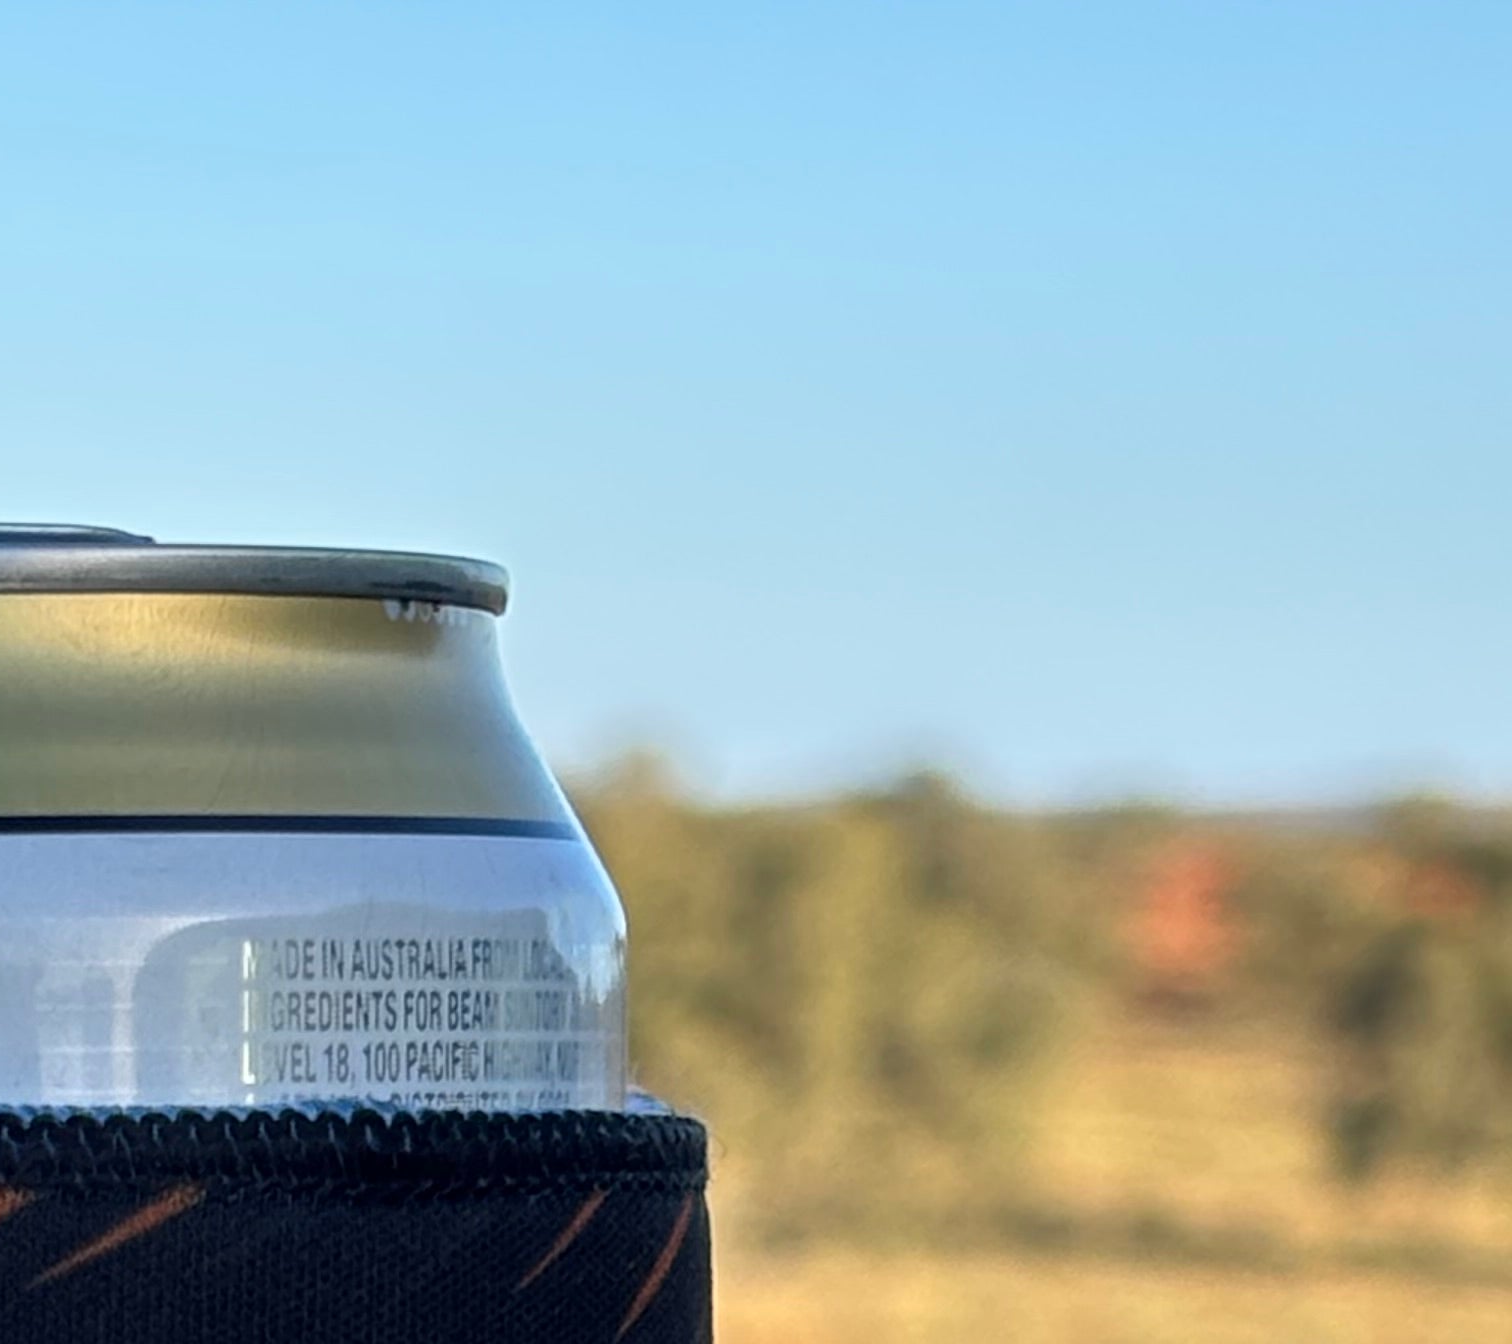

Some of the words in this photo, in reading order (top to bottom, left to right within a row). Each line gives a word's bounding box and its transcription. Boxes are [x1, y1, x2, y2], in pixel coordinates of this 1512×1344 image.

[321, 939, 344, 980] IN
[351, 938, 468, 980] AUSTRALIA
[403, 990, 442, 1032] FOR
[324, 1042, 356, 1089] 18,
[363, 1041, 400, 1082] 100
[406, 1040, 478, 1082] PACIFIC
